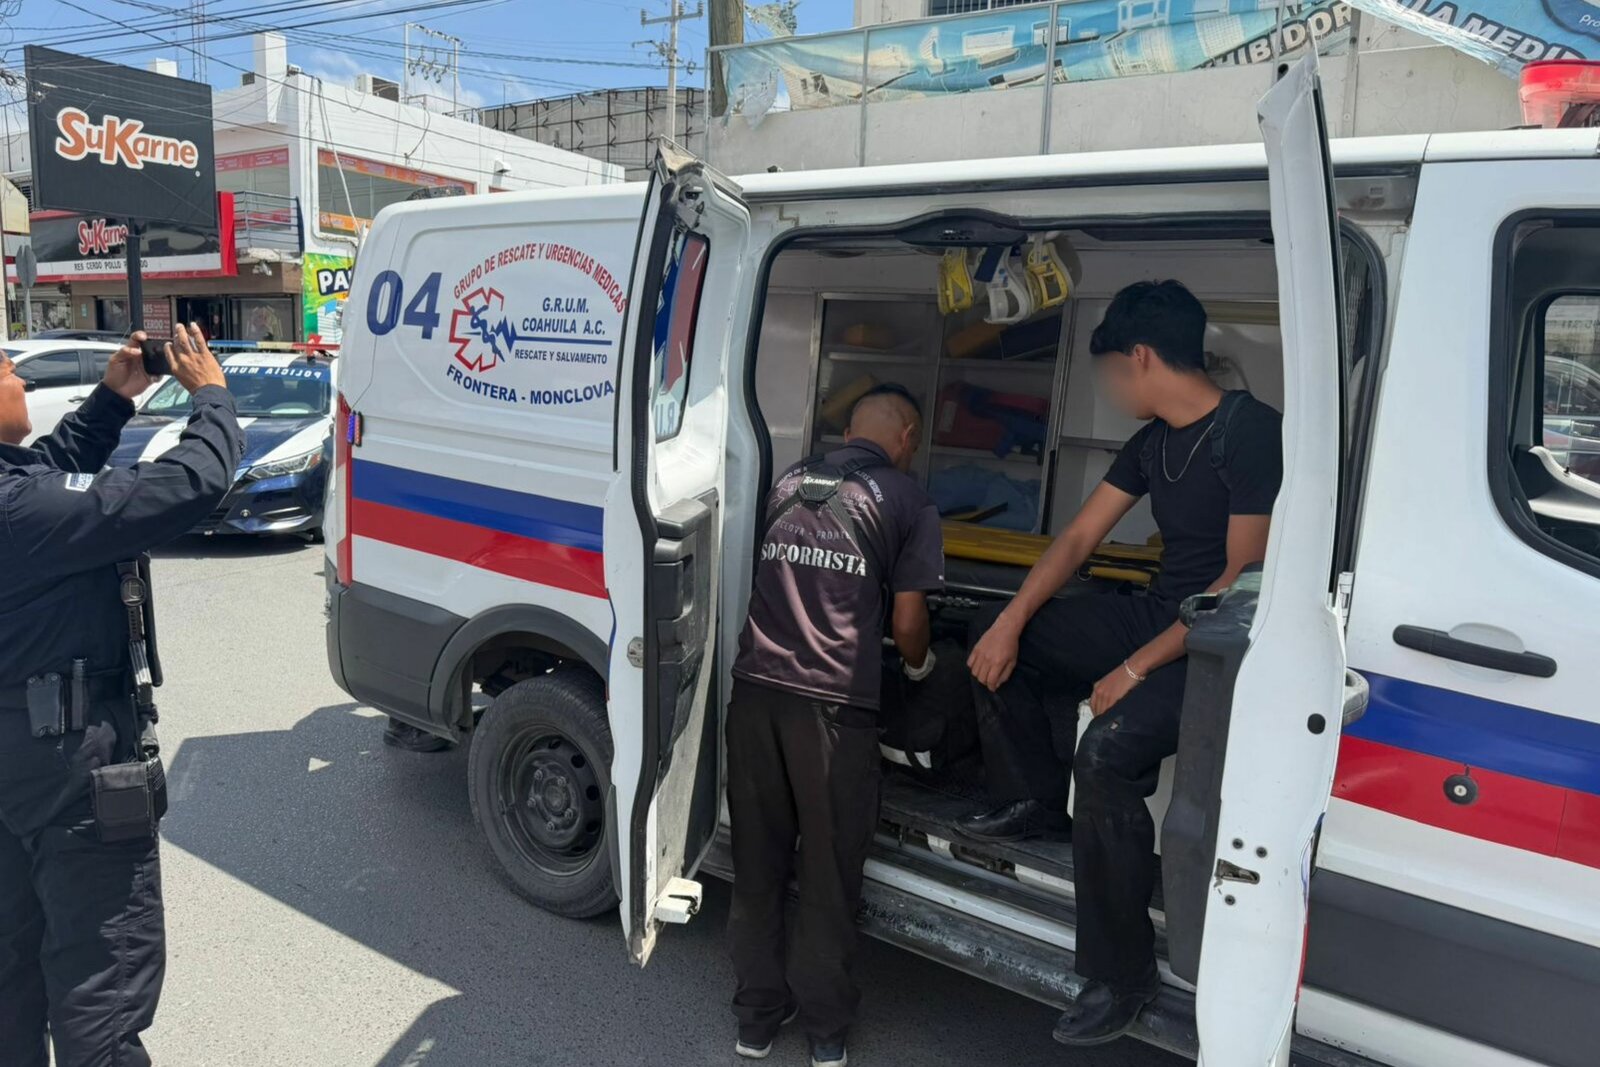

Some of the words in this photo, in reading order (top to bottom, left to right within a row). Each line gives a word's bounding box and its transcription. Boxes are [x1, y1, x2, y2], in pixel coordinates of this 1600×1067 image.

[1462, 16, 1583, 60] MEDI
[56, 107, 199, 169] SuKarne
[78, 218, 128, 255] SuKarne
[318, 268, 352, 294] PA
[453, 263, 482, 299] GRUPO
[484, 255, 496, 275] DE
[497, 243, 537, 268] RESCATE
[538, 242, 546, 259] Y
[545, 242, 594, 275] URGENCIAS
[592, 263, 629, 314] MEDICAS
[366, 270, 443, 340] 04
[542, 297, 589, 313] G.R.U.M.
[522, 316, 577, 334] COAHUILA
[583, 319, 606, 336] A.C.
[514, 348, 549, 361] RESCATE
[549, 351, 555, 362] Y
[556, 351, 608, 365] SALVAMENTO
[446, 363, 518, 403] FRONTERA
[530, 379, 615, 405] MONCLOVA
[760, 543, 867, 577] SOCORRISTA
